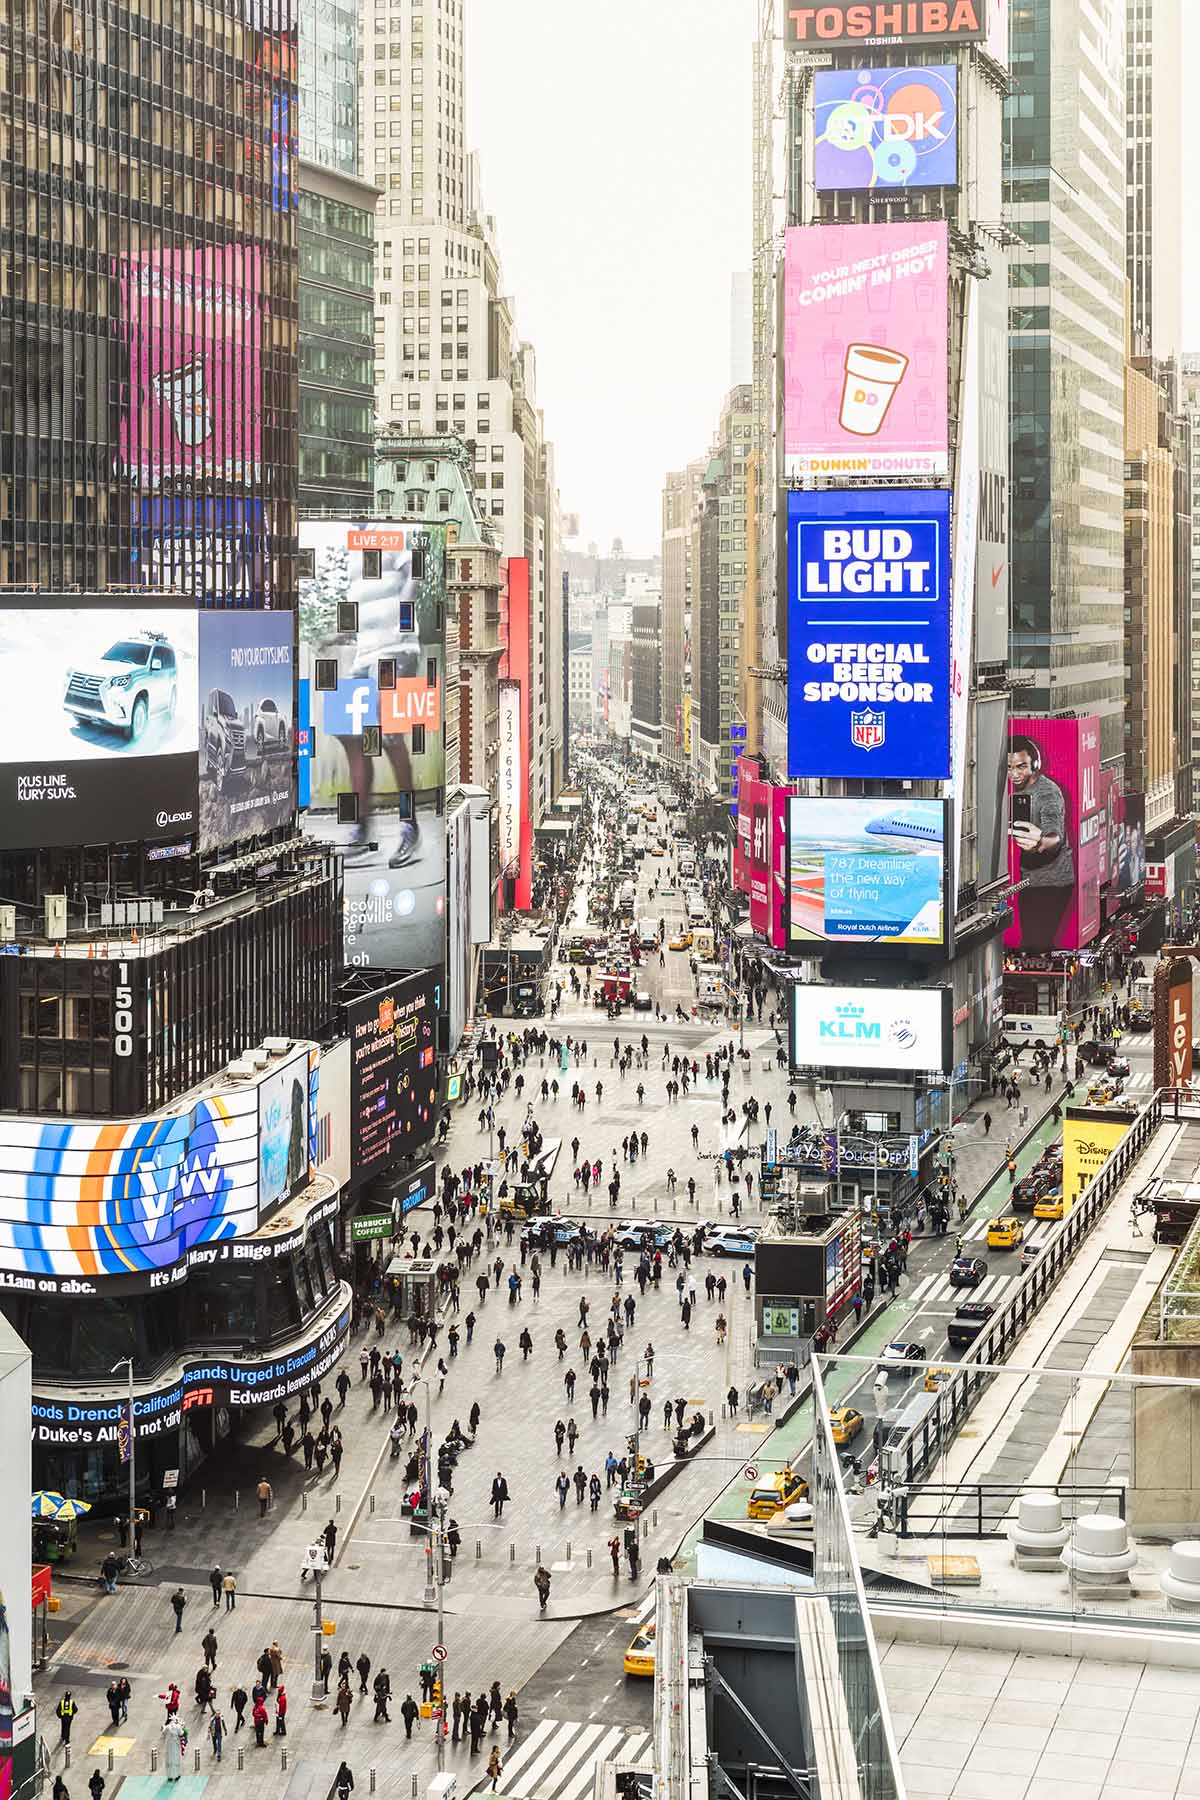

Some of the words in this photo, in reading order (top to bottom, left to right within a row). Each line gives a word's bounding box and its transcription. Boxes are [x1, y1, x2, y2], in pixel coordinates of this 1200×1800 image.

[788, 0, 979, 40] TOSHIBA
[864, 36, 903, 46] TOSHIBA
[861, 111, 945, 141] TDK
[811, 266, 849, 285] YOUR
[851, 254, 889, 274] NEXT
[891, 240, 938, 262] ORDER
[799, 274, 867, 306] COMIN'
[871, 266, 892, 286] IN
[896, 254, 937, 279] HOT
[854, 389, 878, 405] DD
[979, 470, 1005, 544] MADE
[353, 536, 377, 546] LIVE
[380, 536, 400, 546] 2:17
[823, 530, 913, 560] BUD
[806, 643, 930, 664] OFFICIAL
[833, 663, 903, 682] BEER
[803, 682, 933, 703] SPONSOR
[393, 692, 435, 718] LIVE
[855, 727, 880, 744] NFL
[43, 775, 66, 786] LINE
[1082, 766, 1096, 812] ALL
[168, 812, 192, 822] LEXUS
[753, 817, 767, 863] #1
[831, 858, 855, 870] 787
[831, 872, 854, 884] the
[856, 875, 880, 885] new
[883, 876, 905, 887] way
[830, 888, 844, 898] of
[848, 888, 879, 901] flying
[837, 924, 858, 932] Royal
[114, 963, 133, 1056] 1500
[355, 1023, 367, 1038] How
[819, 1021, 881, 1039] KLM
[356, 1227, 383, 1236] COFFEE
[190, 1249, 217, 1263] Mary
[220, 1246, 229, 1259] J
[233, 1244, 271, 1260] Blige
[0, 1272, 35, 1292] 11am
[38, 1278, 57, 1292] on
[61, 1279, 96, 1294] abc.
[150, 1271, 169, 1287] It's
[132, 1388, 181, 1416] California
[230, 1366, 273, 1385] Urged
[275, 1364, 285, 1376] to
[230, 1384, 286, 1404] Edwards
[287, 1373, 310, 1394] leaves
[39, 1426, 92, 1442] Duke's
[140, 1418, 161, 1436] not
